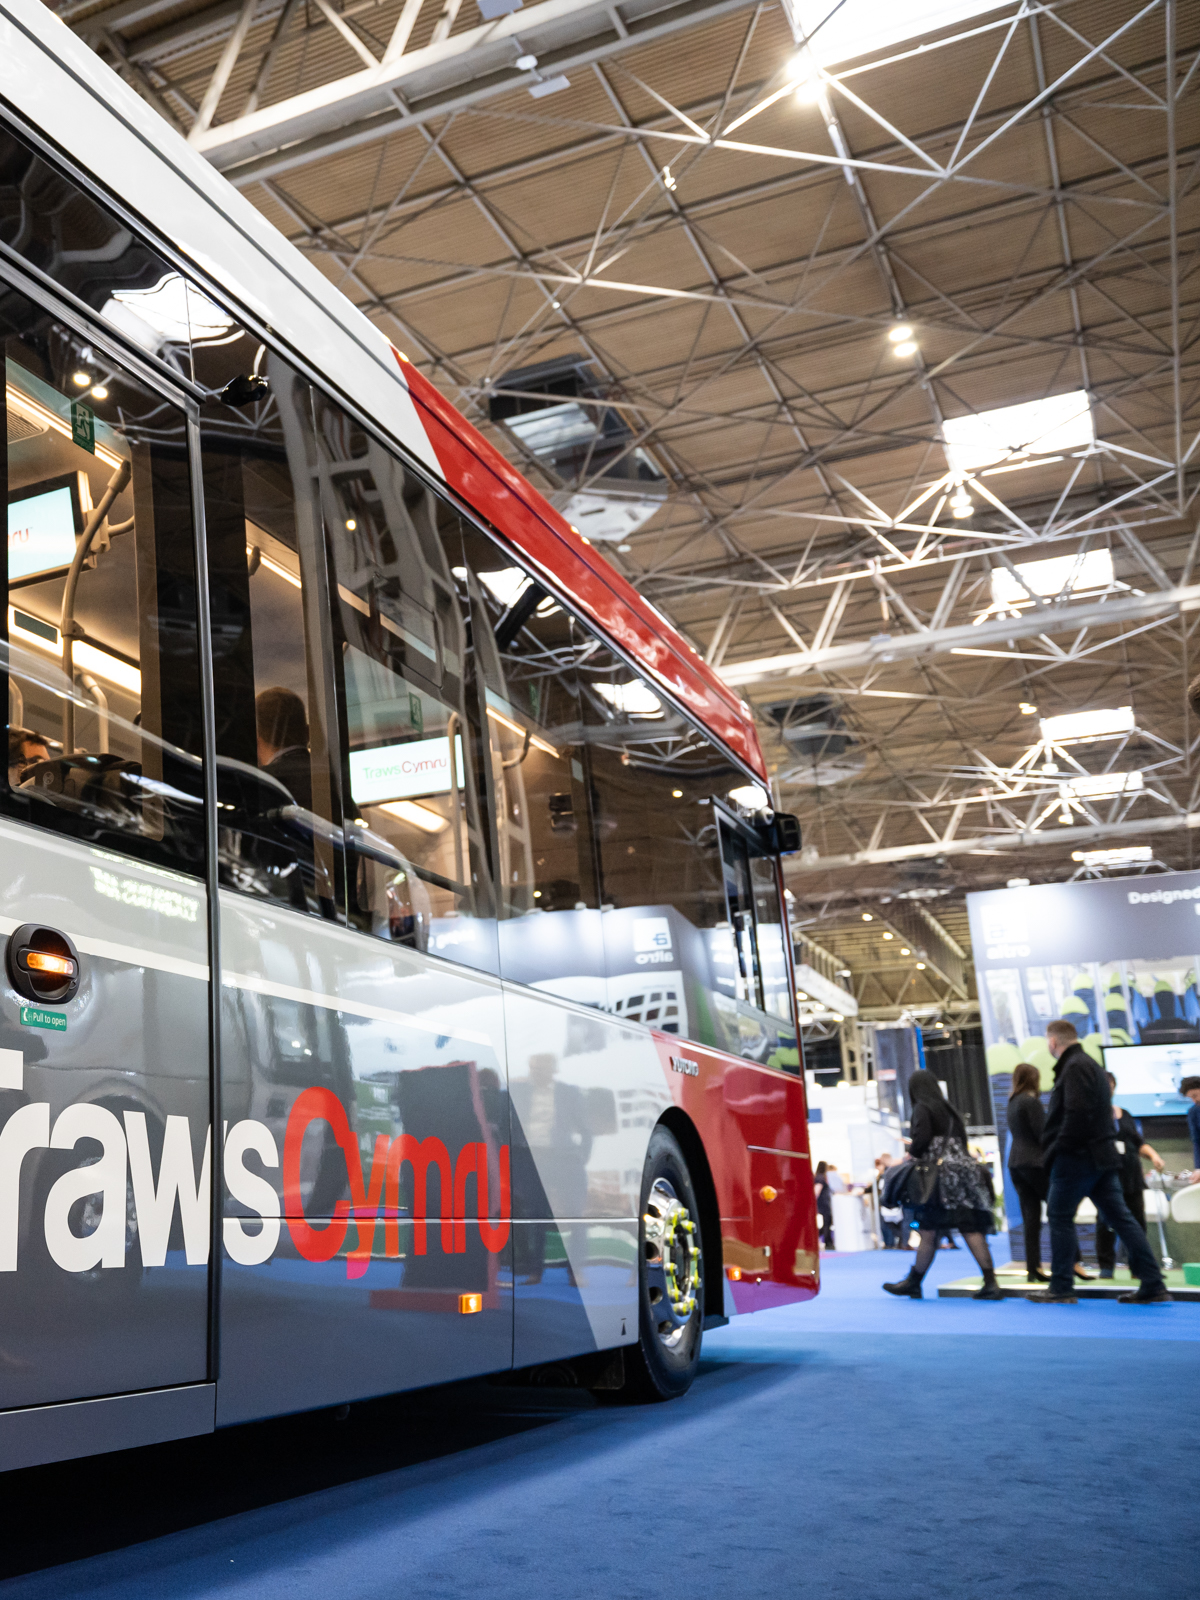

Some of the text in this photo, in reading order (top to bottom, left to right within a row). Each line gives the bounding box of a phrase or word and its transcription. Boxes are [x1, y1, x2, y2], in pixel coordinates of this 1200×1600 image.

[363, 757, 447, 779] TrawsCymru
[32, 1012, 66, 1027] Pull to open
